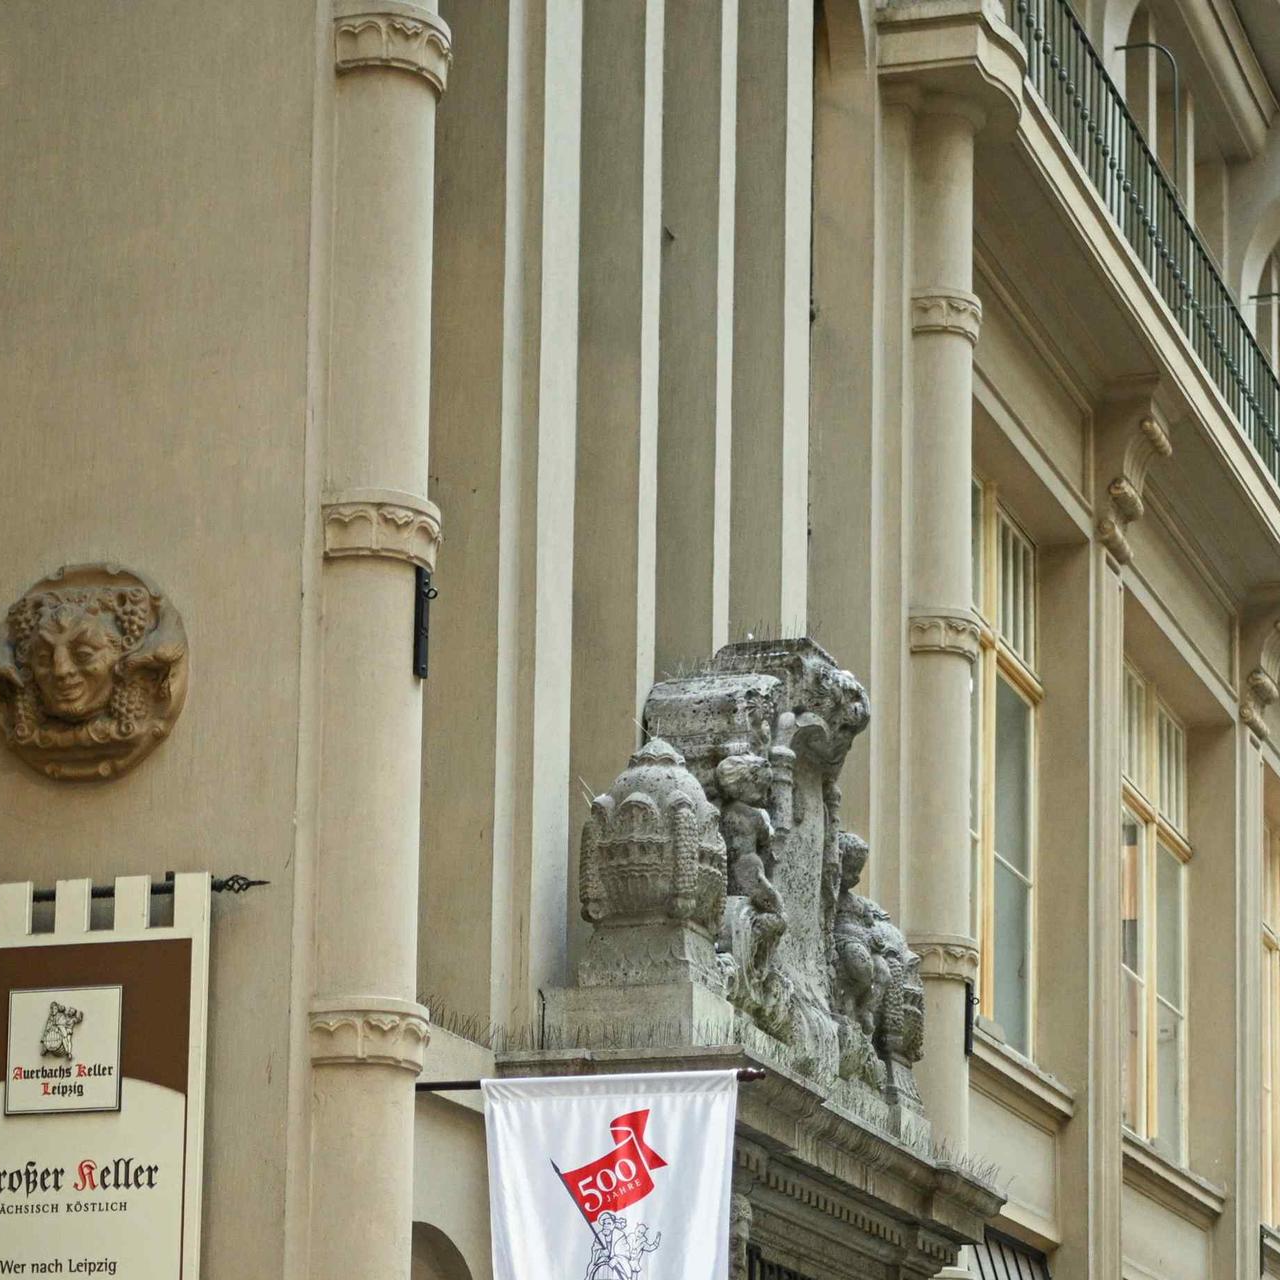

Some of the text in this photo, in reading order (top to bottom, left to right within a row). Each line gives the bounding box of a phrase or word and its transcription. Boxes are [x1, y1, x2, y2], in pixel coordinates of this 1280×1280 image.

[12, 1062, 114, 1082] Auerbachs Keller
[41, 1080, 85, 1098] Leipzig
[72, 1157, 160, 1192] Keller
[577, 1158, 637, 1212] 500
[606, 1178, 642, 1203] JAHRE
[66, 1199, 128, 1214] KÖSTLICH
[31, 1258, 63, 1275] nach
[68, 1258, 118, 1277] Leipzig
